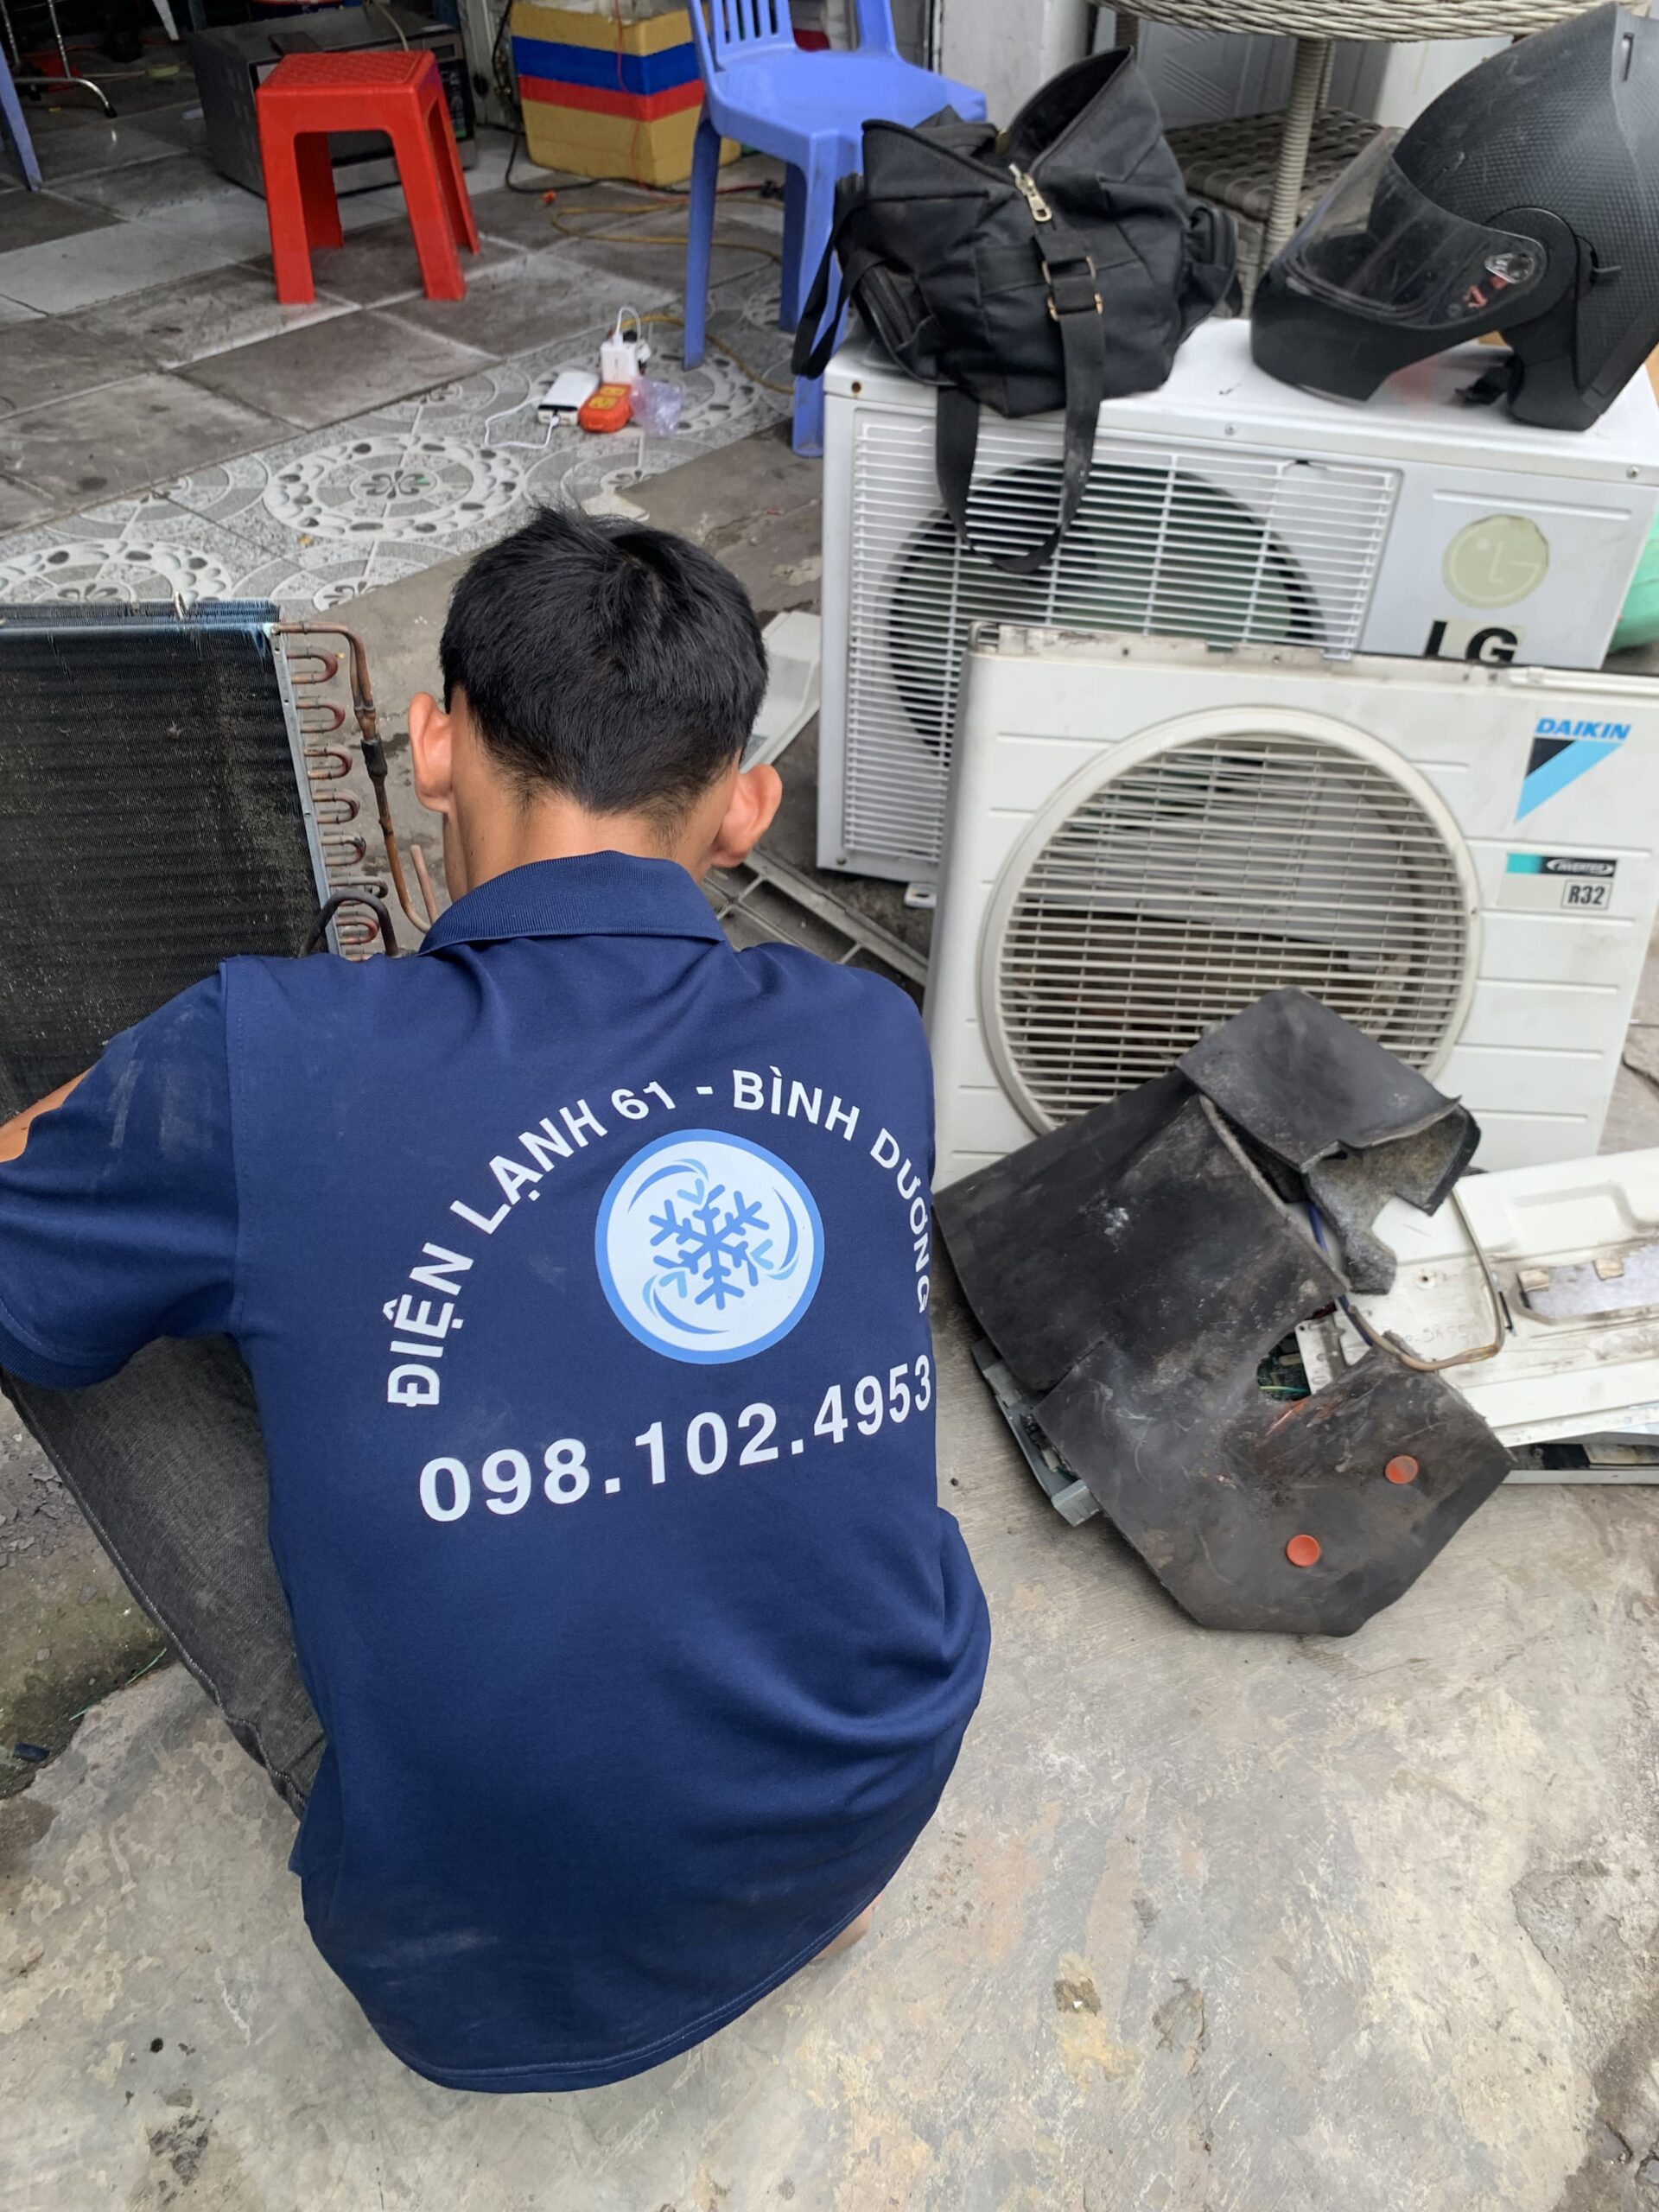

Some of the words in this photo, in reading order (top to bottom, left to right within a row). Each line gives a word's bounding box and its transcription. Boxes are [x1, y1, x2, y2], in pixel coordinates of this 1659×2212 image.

[1535, 717, 1631, 740] DAIKIN
[1567, 885, 1605, 906] R32
[382, 1242, 474, 1407] ĐIỆN
[449, 1098, 608, 1235] LẠNH
[611, 1081, 676, 1120] 61
[696, 1085, 714, 1095] -
[733, 1065, 861, 1141] BÌNH
[869, 1128, 931, 1314] DƯƠNG
[419, 1354, 932, 1522] 098.102.4953
